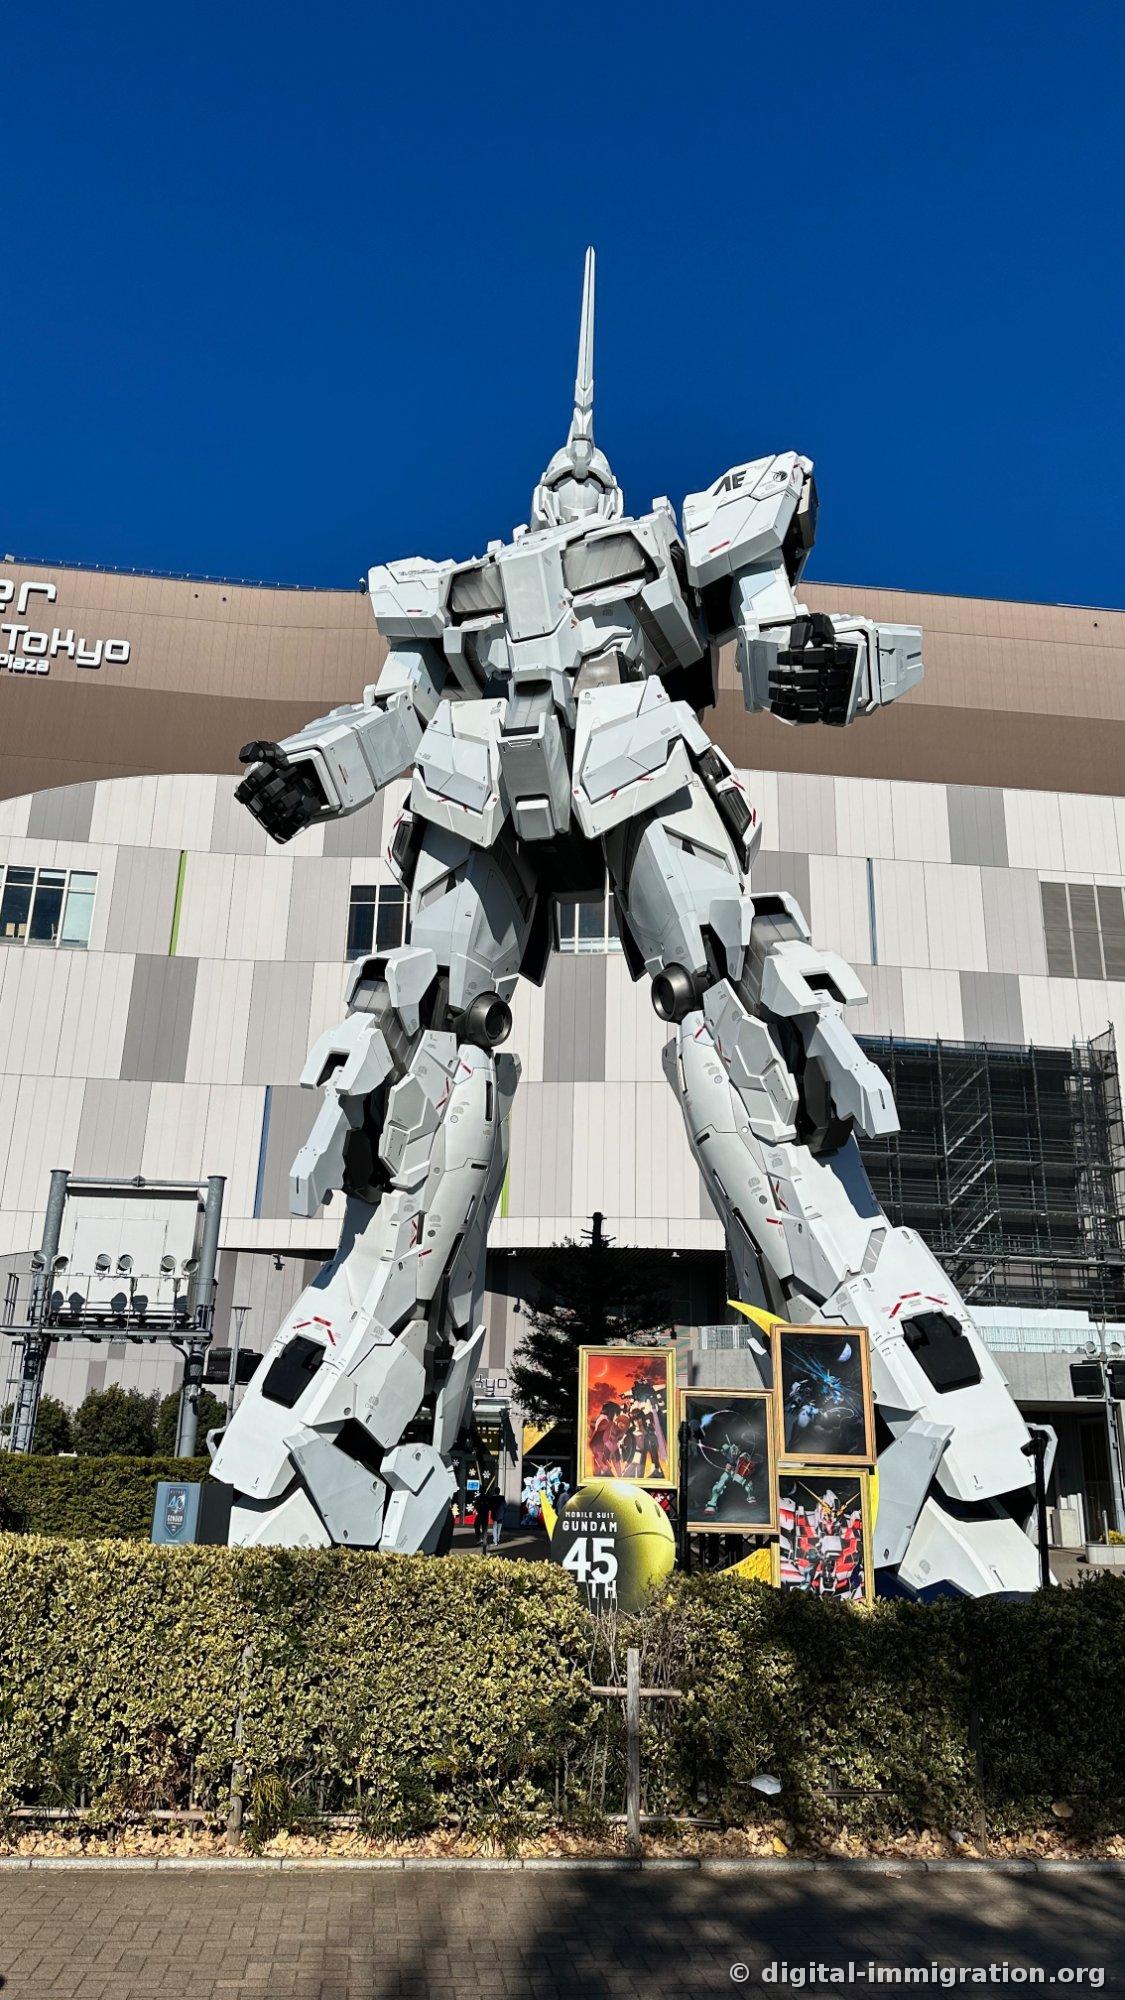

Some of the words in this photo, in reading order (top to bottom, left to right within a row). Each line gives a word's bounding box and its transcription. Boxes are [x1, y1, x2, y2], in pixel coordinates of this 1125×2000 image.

[713, 470, 747, 496] AE
[565, 1511, 593, 1519] MOBILE
[596, 1511, 615, 1519] SUIT
[562, 1520, 618, 1533] GUNDAM
[562, 1537, 618, 1583] 45
